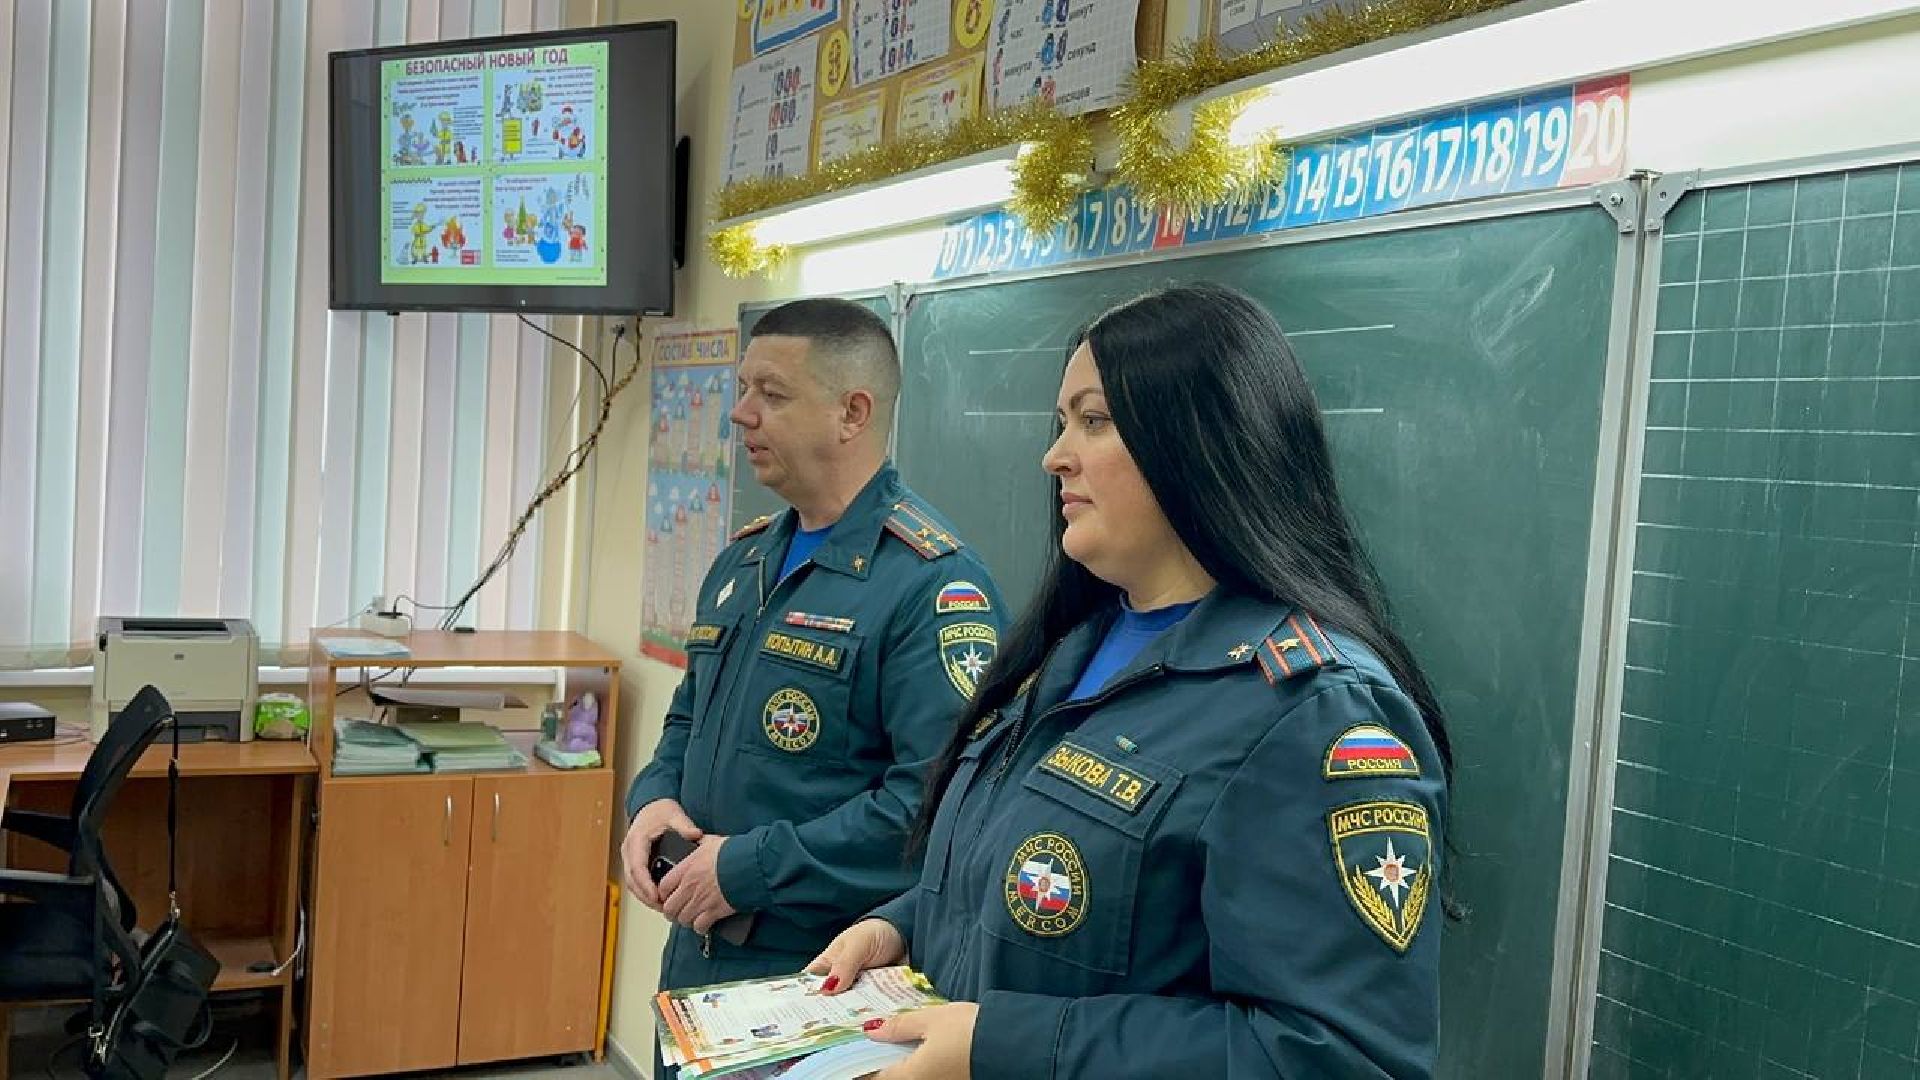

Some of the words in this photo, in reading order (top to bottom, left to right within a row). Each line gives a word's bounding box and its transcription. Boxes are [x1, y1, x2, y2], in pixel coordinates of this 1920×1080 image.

[406, 51, 486, 75] БЕЗОПАСНЫЙ
[489, 47, 536, 68] НОВЫЙ
[543, 48, 568, 65] ГОД
[962, 227, 975, 267] 1
[978, 222, 996, 265] 2
[999, 218, 1015, 263] 3
[1064, 205, 1080, 252] 6
[1088, 200, 1102, 250] 7
[1111, 197, 1127, 246] 8
[1136, 198, 1154, 242] 9
[1295, 157, 1331, 216] 14
[1333, 146, 1370, 209] 15
[1374, 138, 1415, 202] 16
[1421, 126, 1463, 194] 17
[1469, 116, 1516, 185] 18
[1522, 107, 1567, 177] 19
[1571, 94, 1628, 163] 20
[1348, 758, 1402, 770] РОССИЯ
[1110, 773, 1142, 805] Т.В.
[1338, 810, 1372, 833] МЧС
[1373, 808, 1427, 829] РОССИИ
[1018, 840, 1042, 865] МЧС
[1046, 838, 1081, 896] РОССИИ
